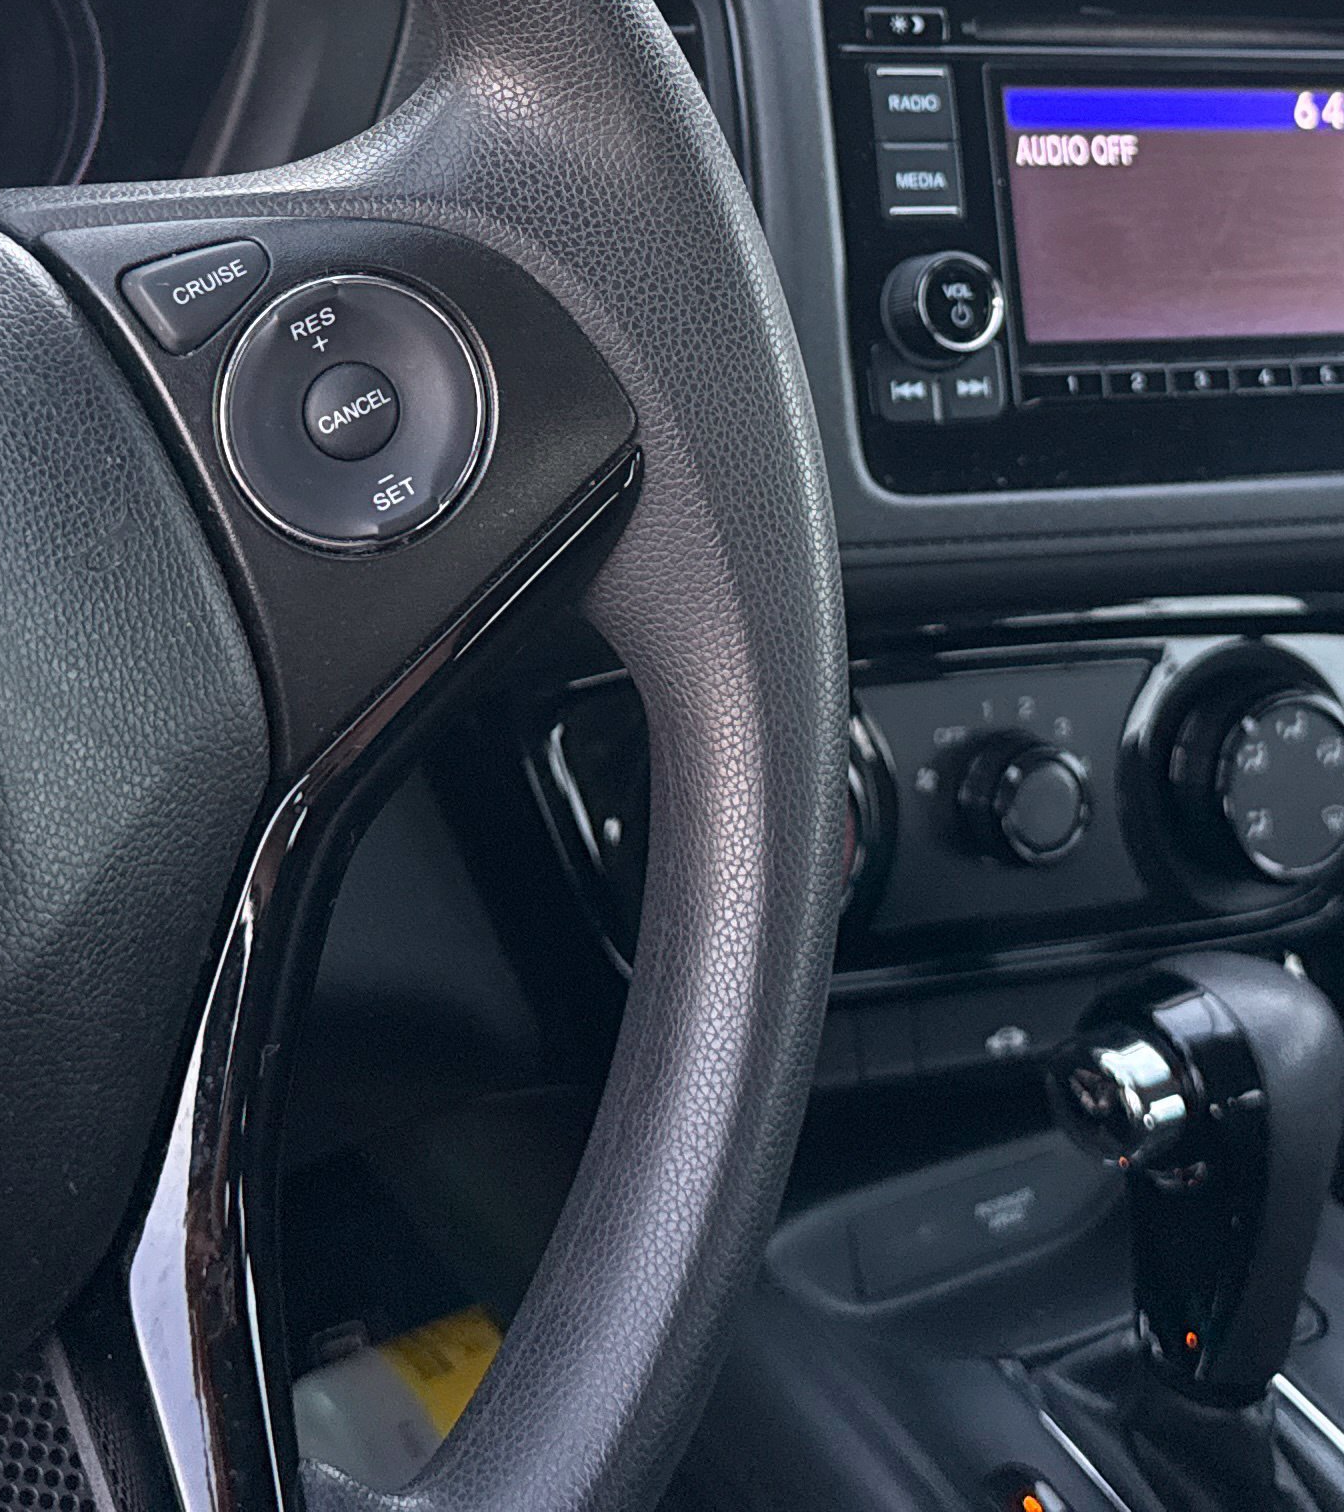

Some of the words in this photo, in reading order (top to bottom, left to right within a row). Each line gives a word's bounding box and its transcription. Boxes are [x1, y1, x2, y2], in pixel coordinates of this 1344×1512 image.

[887, 94, 942, 113] RADIO
[1016, 134, 1090, 166] AUDIO
[1091, 134, 1139, 166] OFF
[895, 171, 947, 190] MEDIA
[171, 259, 248, 306] CRUISE
[942, 282, 975, 301] VOL
[289, 307, 337, 342] RES
[1130, 371, 1148, 394] 2
[317, 388, 392, 435] CANCEL
[371, 476, 418, 512] SET
